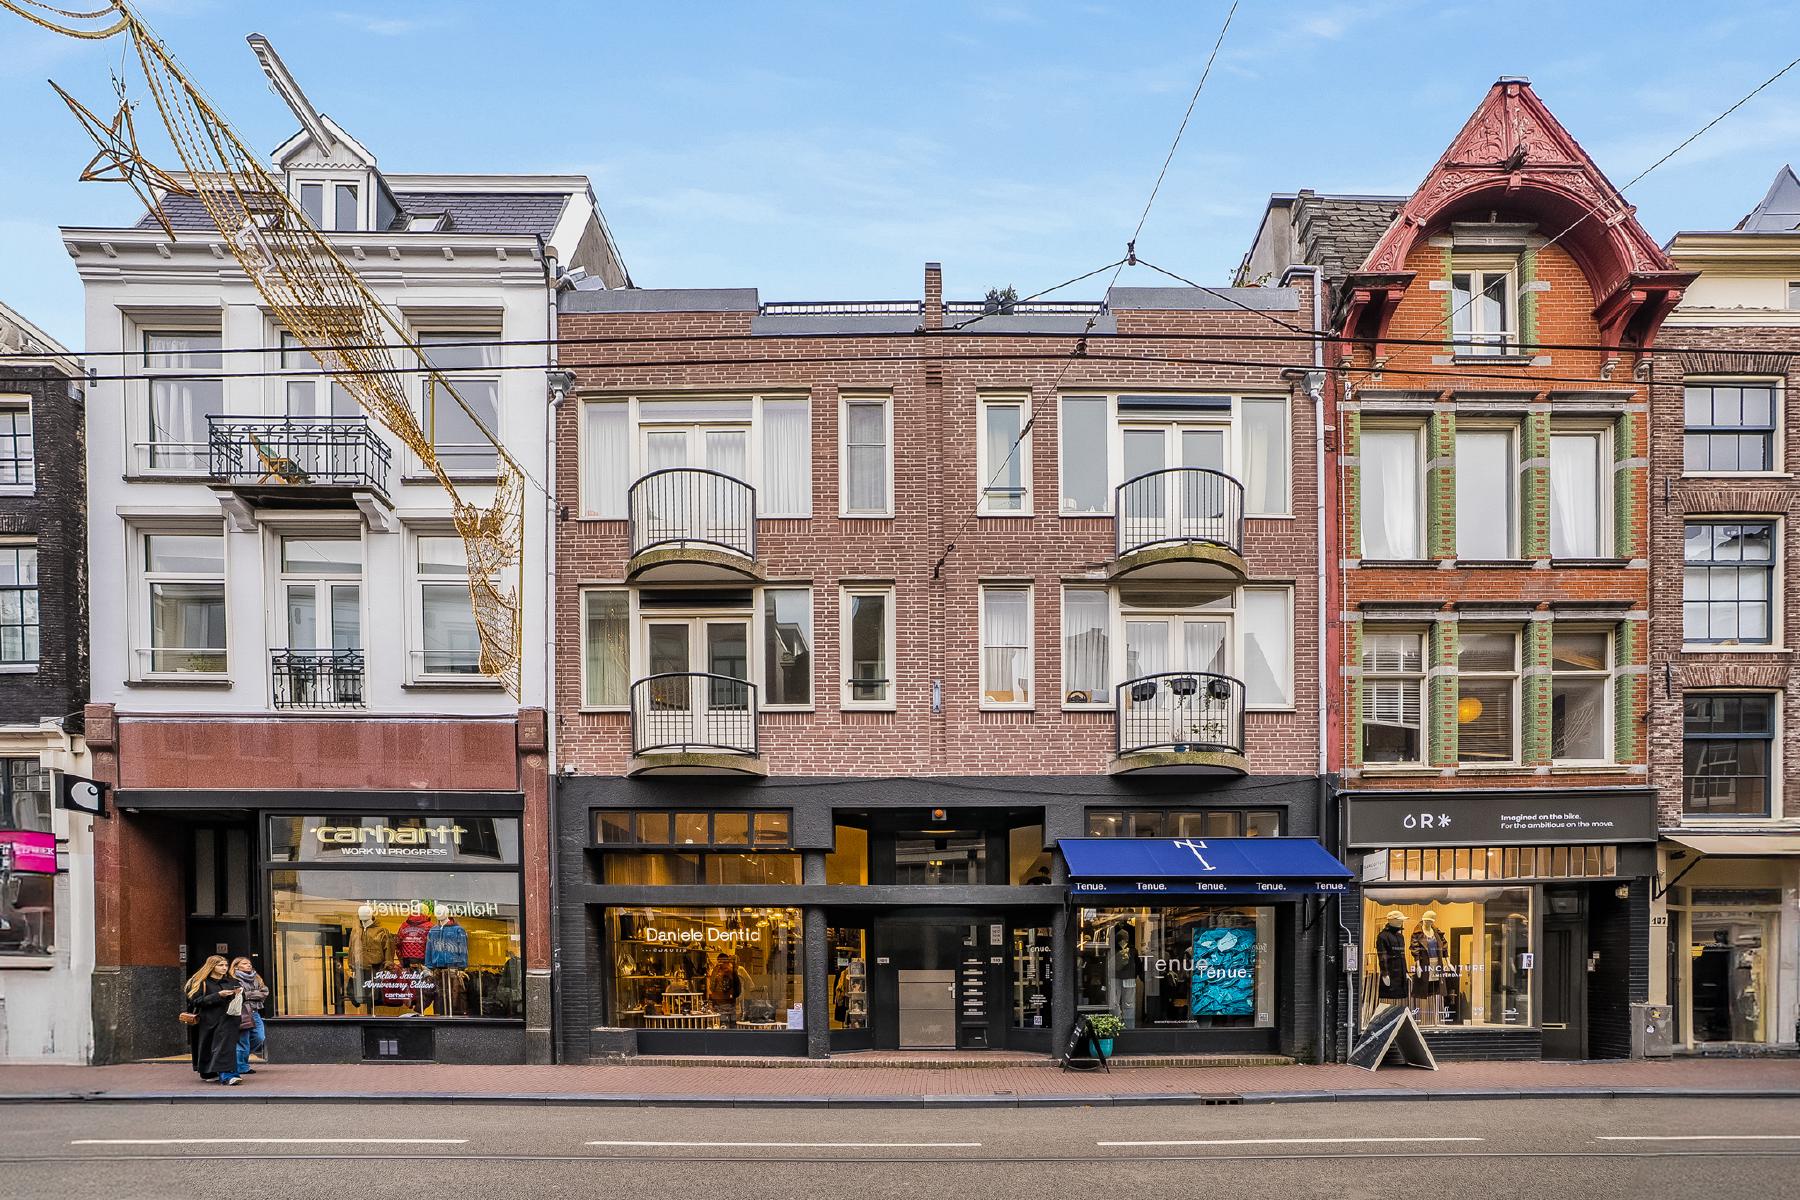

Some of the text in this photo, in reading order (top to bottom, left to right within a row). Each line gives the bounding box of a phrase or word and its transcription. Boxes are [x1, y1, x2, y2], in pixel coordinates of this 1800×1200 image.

[1500, 814, 1537, 823] Imagined
[1563, 812, 1582, 820] bike.
[1527, 821, 1565, 829] ambitious
[310, 824, 468, 845] carhartt
[341, 847, 374, 856] WORK
[388, 847, 448, 856] PROGRESS
[1075, 882, 1107, 890] Tenue.
[1136, 882, 1167, 890] Tenue.
[1195, 882, 1227, 890] Tenue.
[1256, 882, 1287, 890] Tenue.
[1315, 881, 1346, 890] Tenue.
[646, 927, 704, 942] Daniele
[374, 970, 424, 980] Active Jacket
[362, 980, 435, 991] Anniversary Edition
